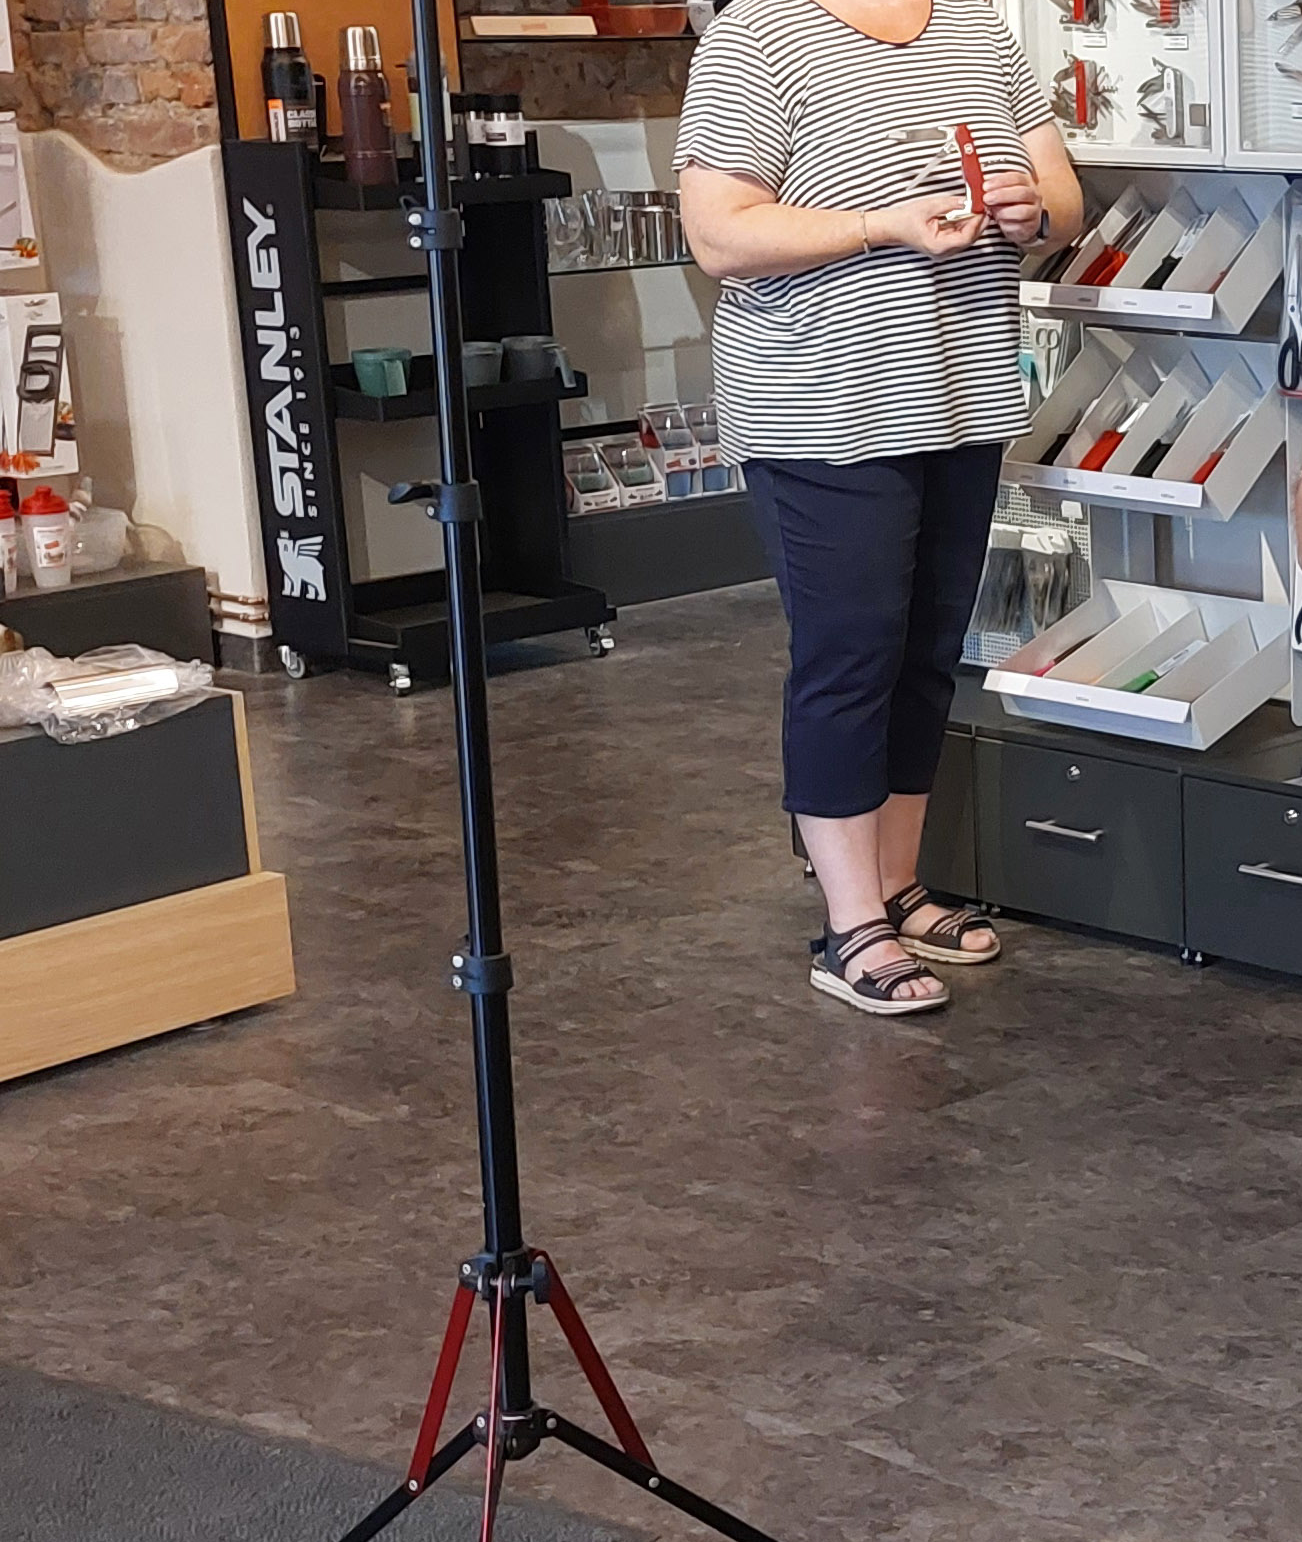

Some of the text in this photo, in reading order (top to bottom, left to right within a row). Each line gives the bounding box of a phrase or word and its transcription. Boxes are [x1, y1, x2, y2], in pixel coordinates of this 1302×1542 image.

[242, 196, 304, 518] STANLEY
[290, 326, 318, 518] SINCE 1913
